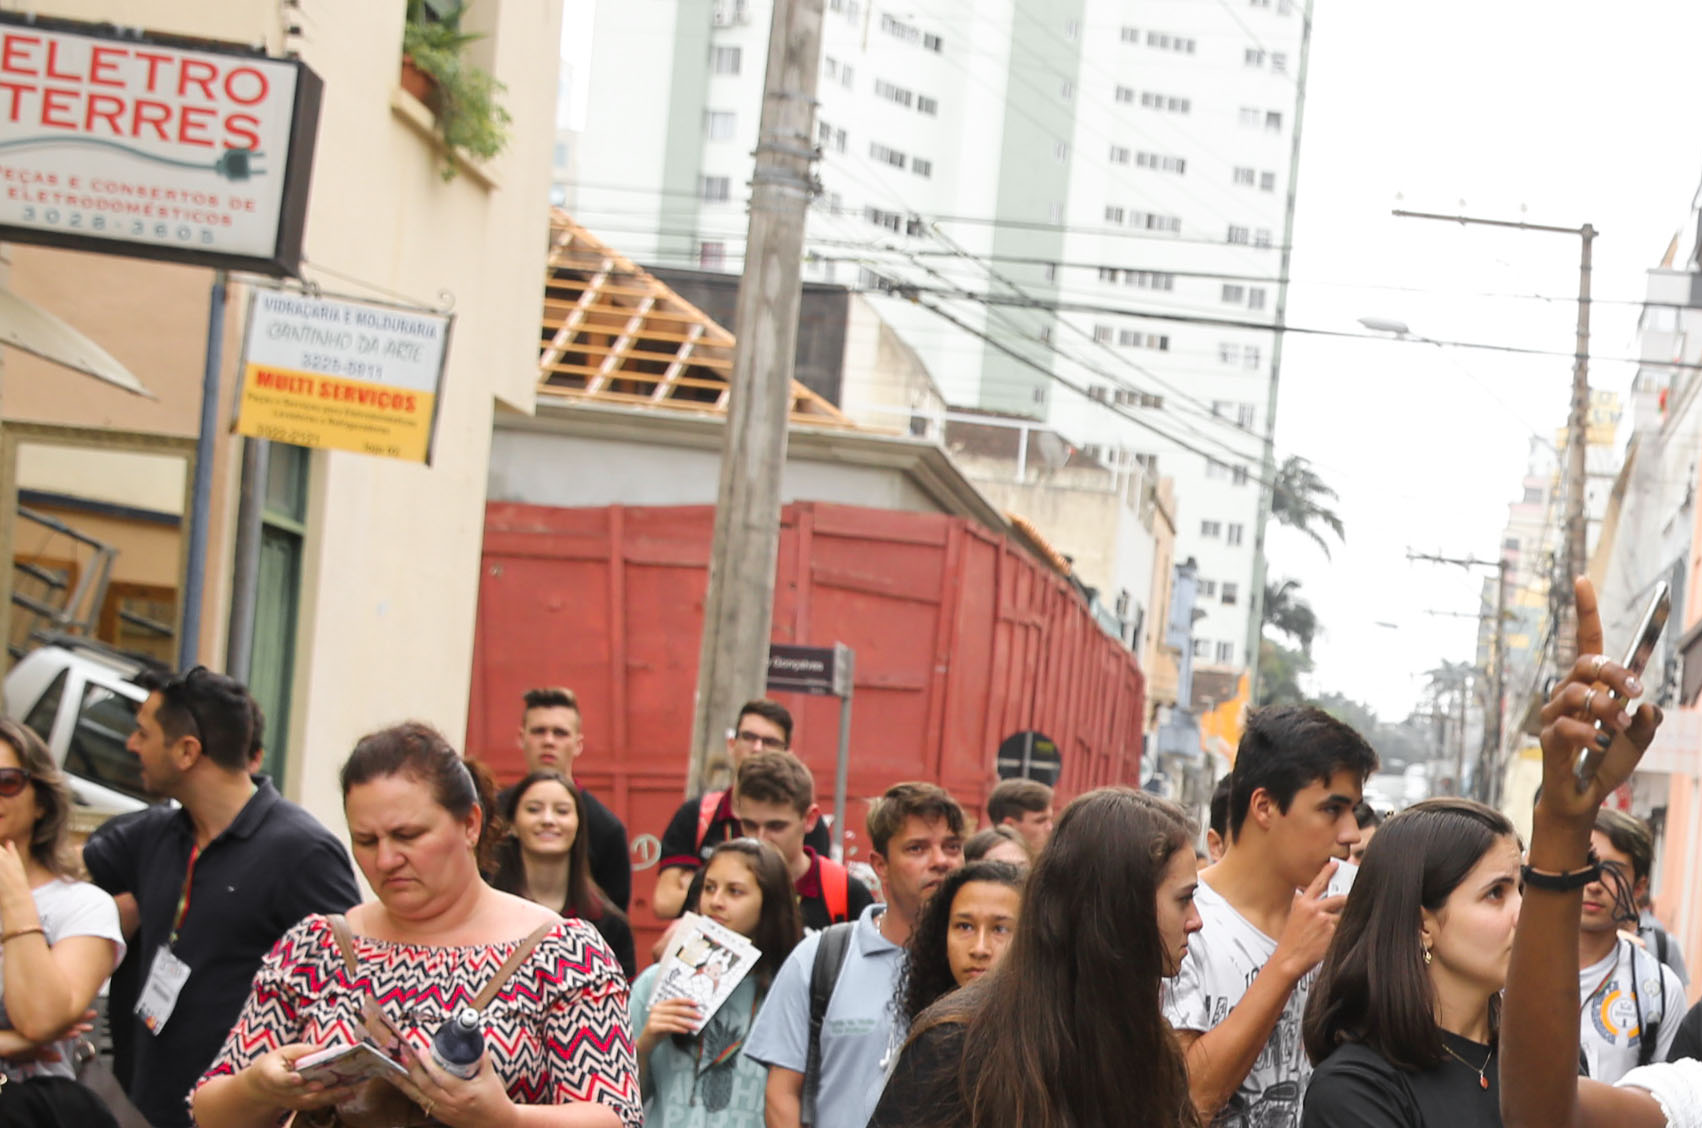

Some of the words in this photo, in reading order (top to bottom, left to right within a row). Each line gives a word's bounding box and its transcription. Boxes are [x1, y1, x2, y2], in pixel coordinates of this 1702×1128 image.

[2, 33, 269, 107] ELETRO
[0, 82, 261, 152] TERRES
[91, 180, 219, 208] CONSERTOS
[229, 198, 256, 212] DE
[256, 369, 316, 396] MULTI
[319, 380, 416, 414] SERVIÇOS
